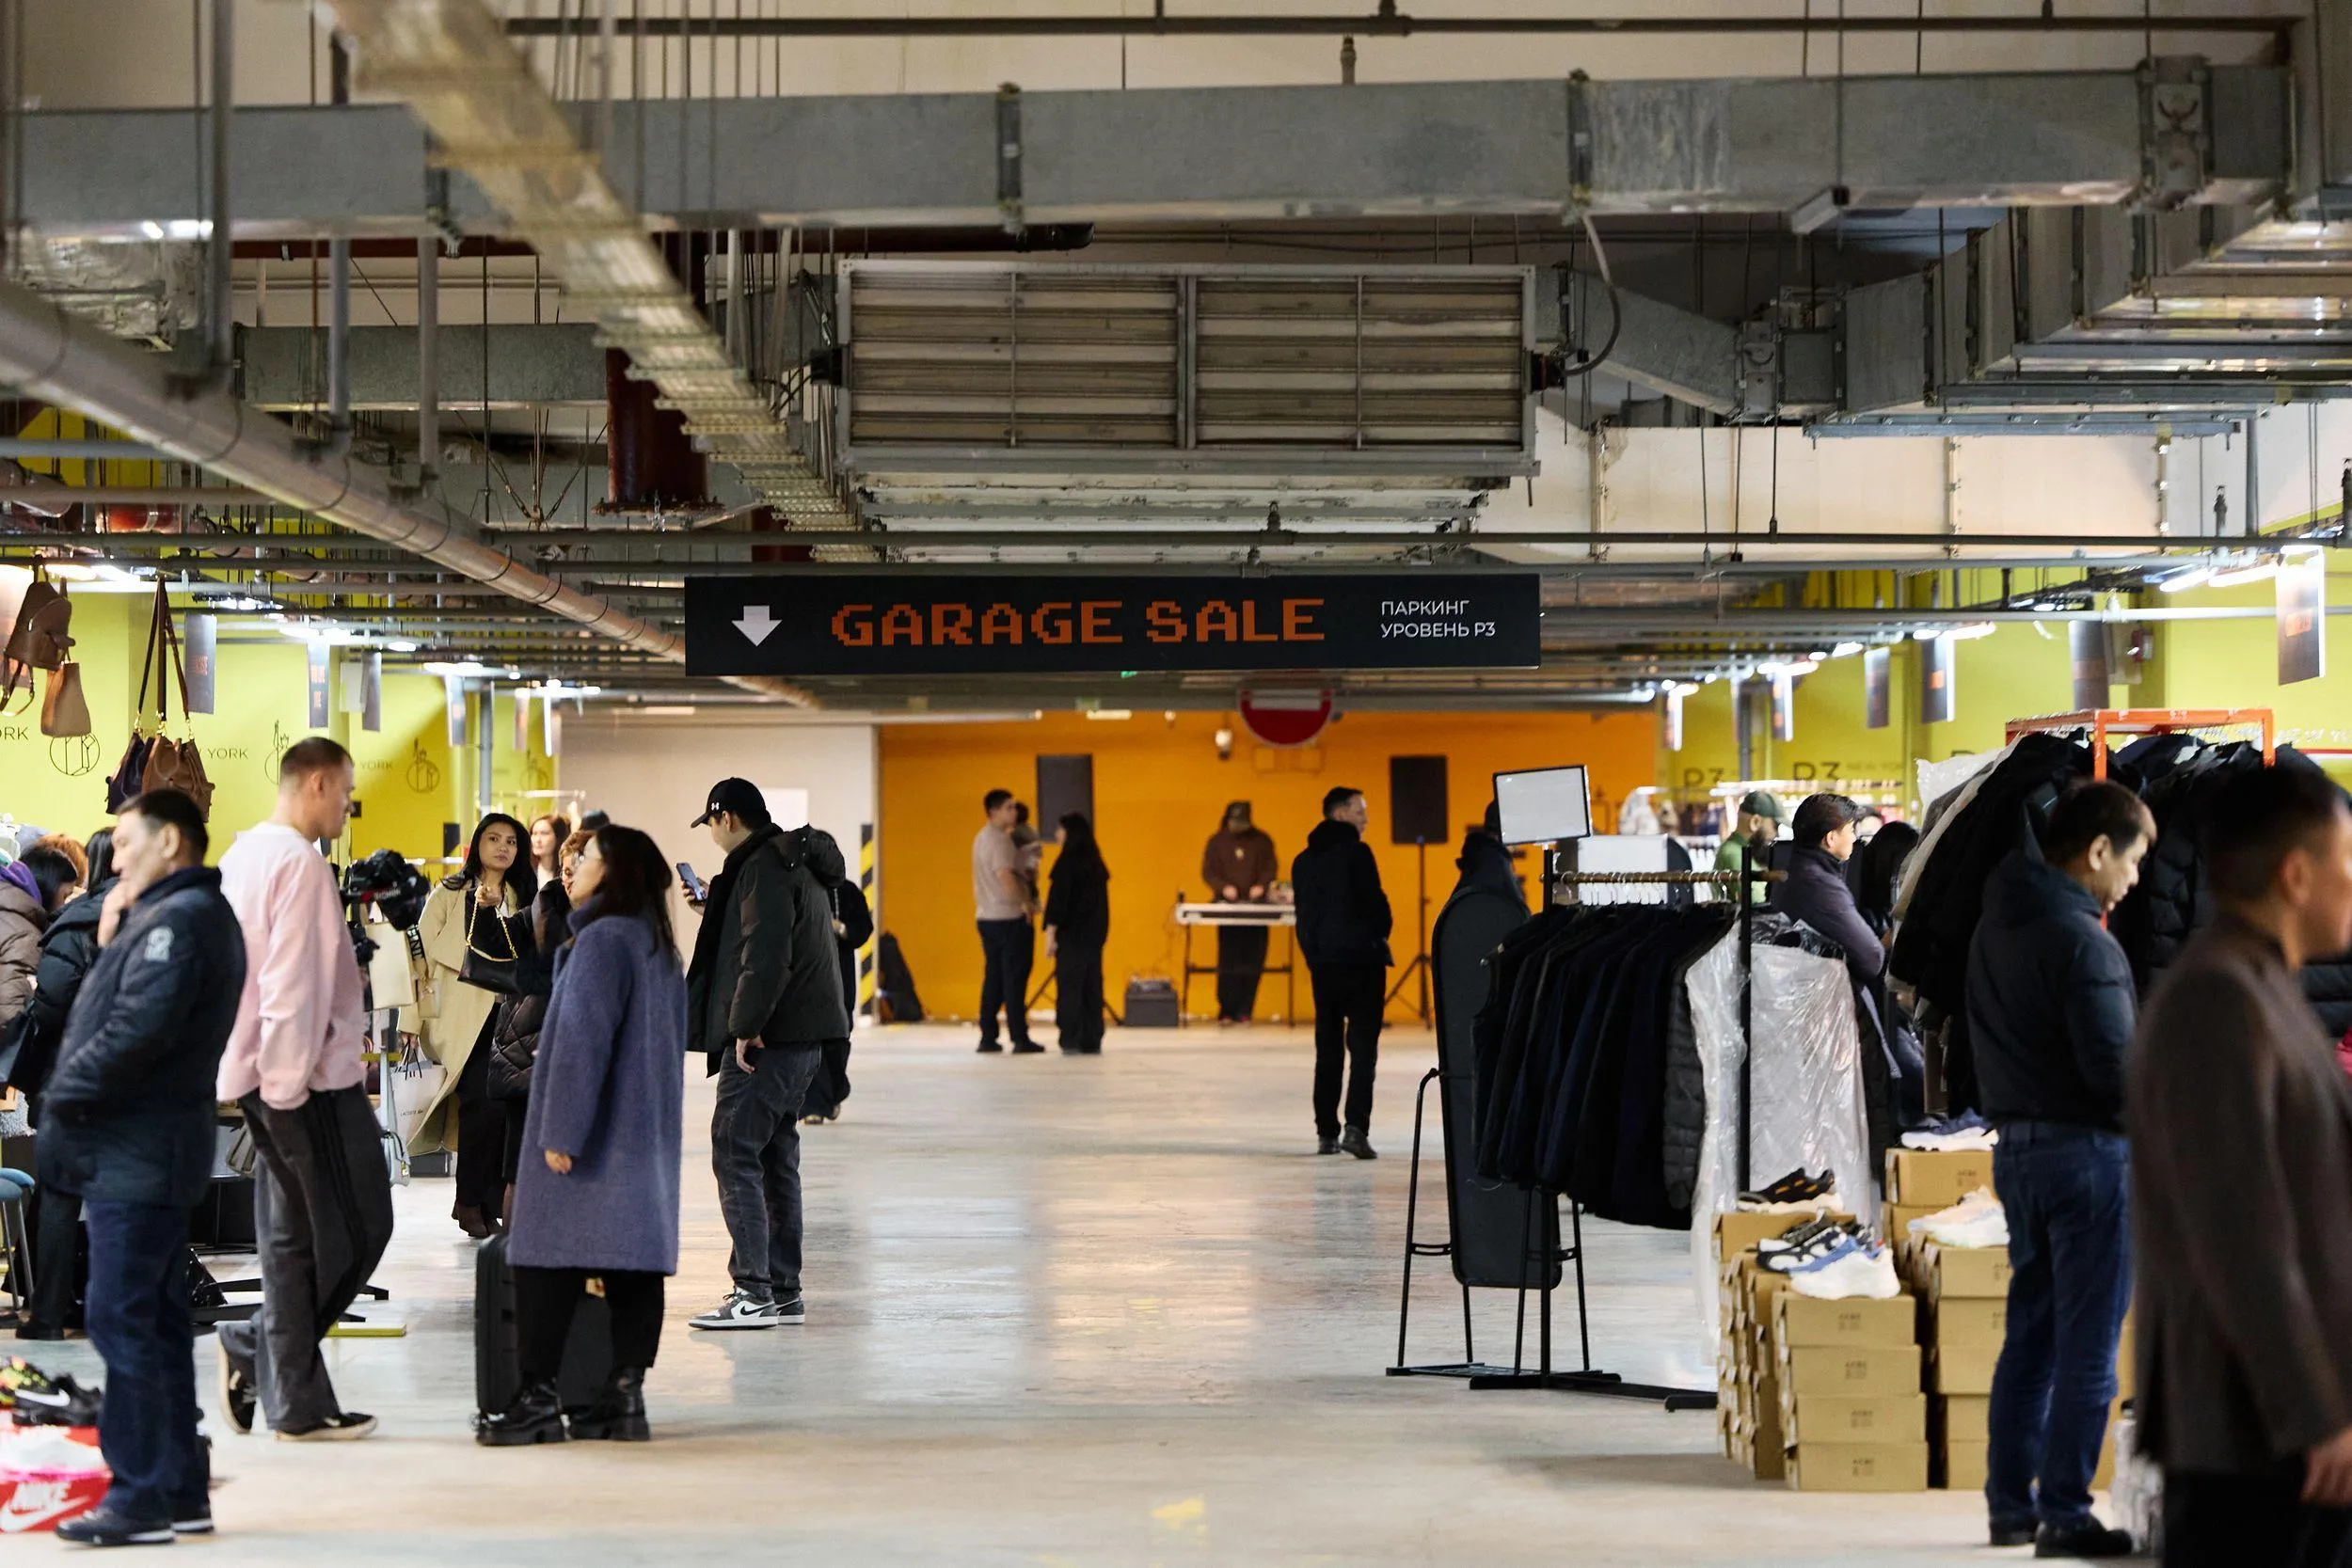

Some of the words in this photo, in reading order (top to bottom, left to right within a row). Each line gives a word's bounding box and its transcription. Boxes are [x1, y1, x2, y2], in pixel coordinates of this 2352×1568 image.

[1381, 600, 1470, 616] ПАРКИНГ
[832, 601, 1123, 646] GARAGE
[1146, 599, 1326, 643] SALE
[1380, 622, 1470, 638] УРОВЕНЬ
[0, 726, 29, 740] RK
[207, 748, 249, 760] YORK
